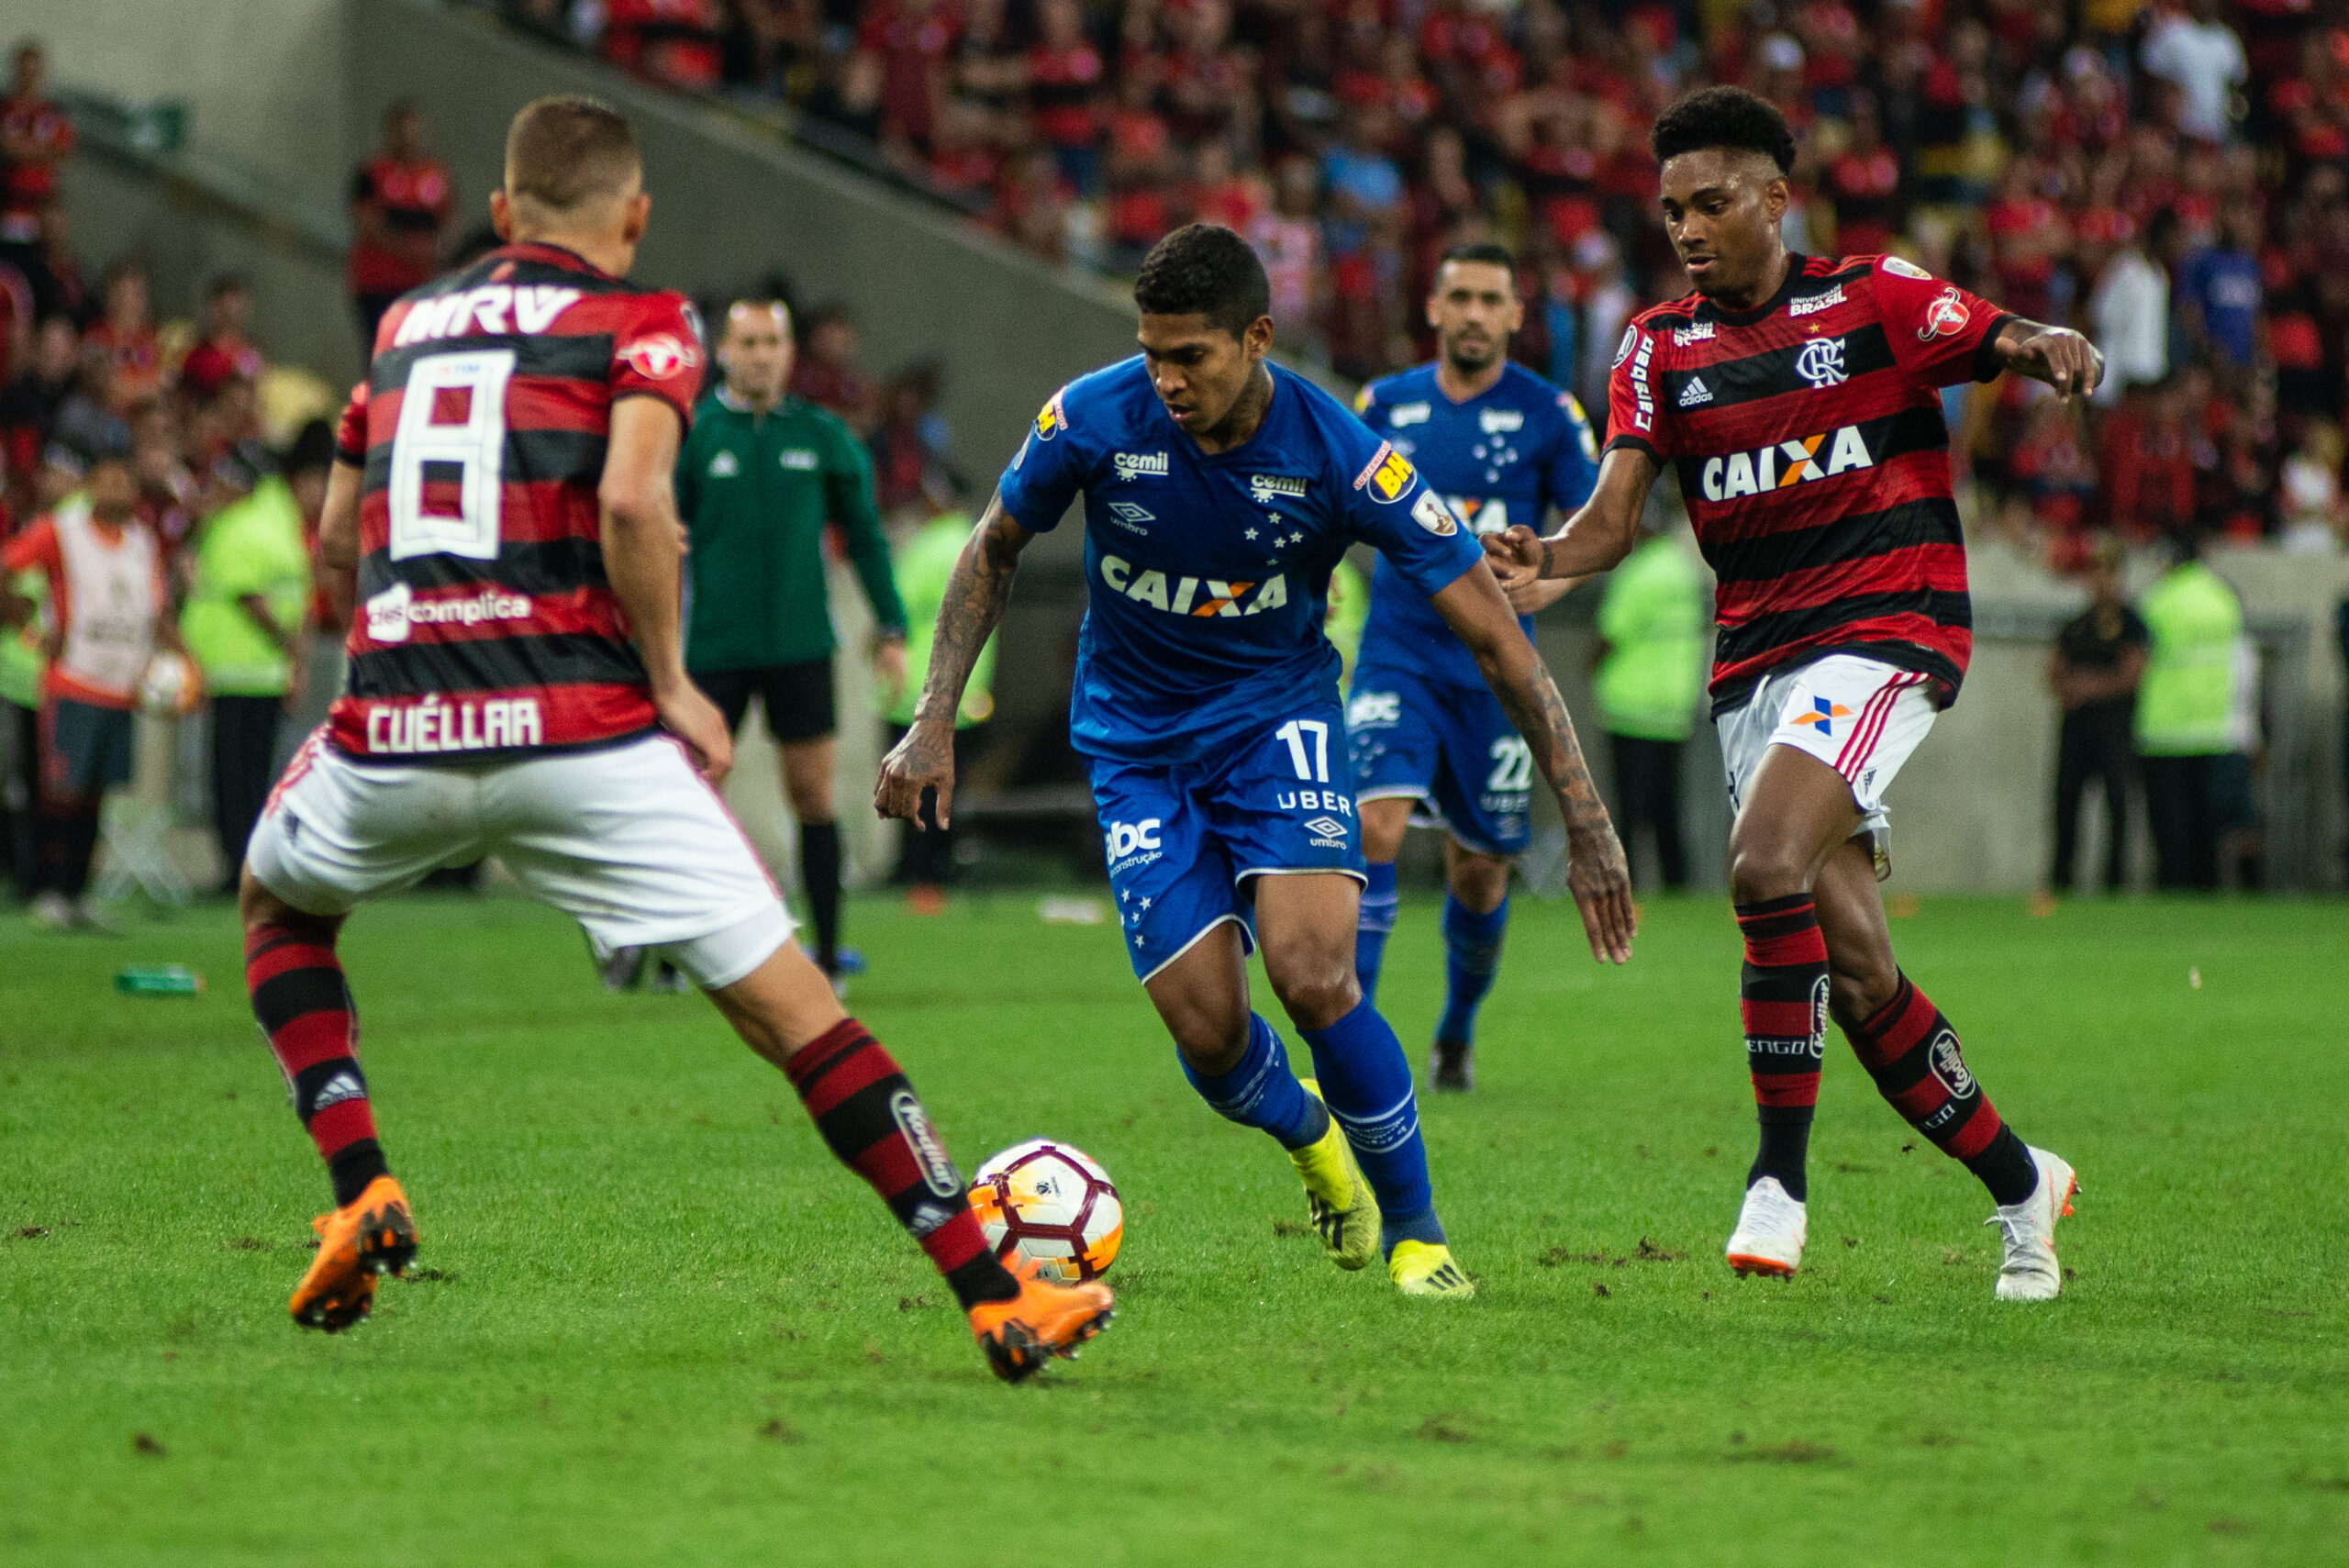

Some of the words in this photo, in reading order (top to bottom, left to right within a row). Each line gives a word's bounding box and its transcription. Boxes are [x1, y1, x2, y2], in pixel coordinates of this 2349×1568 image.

[395, 284, 581, 347] MRV
[1790, 290, 1847, 317] BRASIL
[1679, 392, 1714, 406] adidas
[388, 349, 516, 562] 8
[1114, 451, 1169, 471] cemil
[1375, 450, 1413, 499] BH
[1703, 425, 1873, 502] CAIXA
[1251, 474, 1307, 493] cemil
[1110, 516, 1148, 536] umbro
[1101, 554, 1287, 617] CAIXA
[368, 691, 541, 753] CUÉLLAR
[1275, 719, 1329, 783] 17
[1277, 791, 1352, 817] UBER
[1106, 818, 1161, 866] abc
[1310, 836, 1347, 850] umbro
